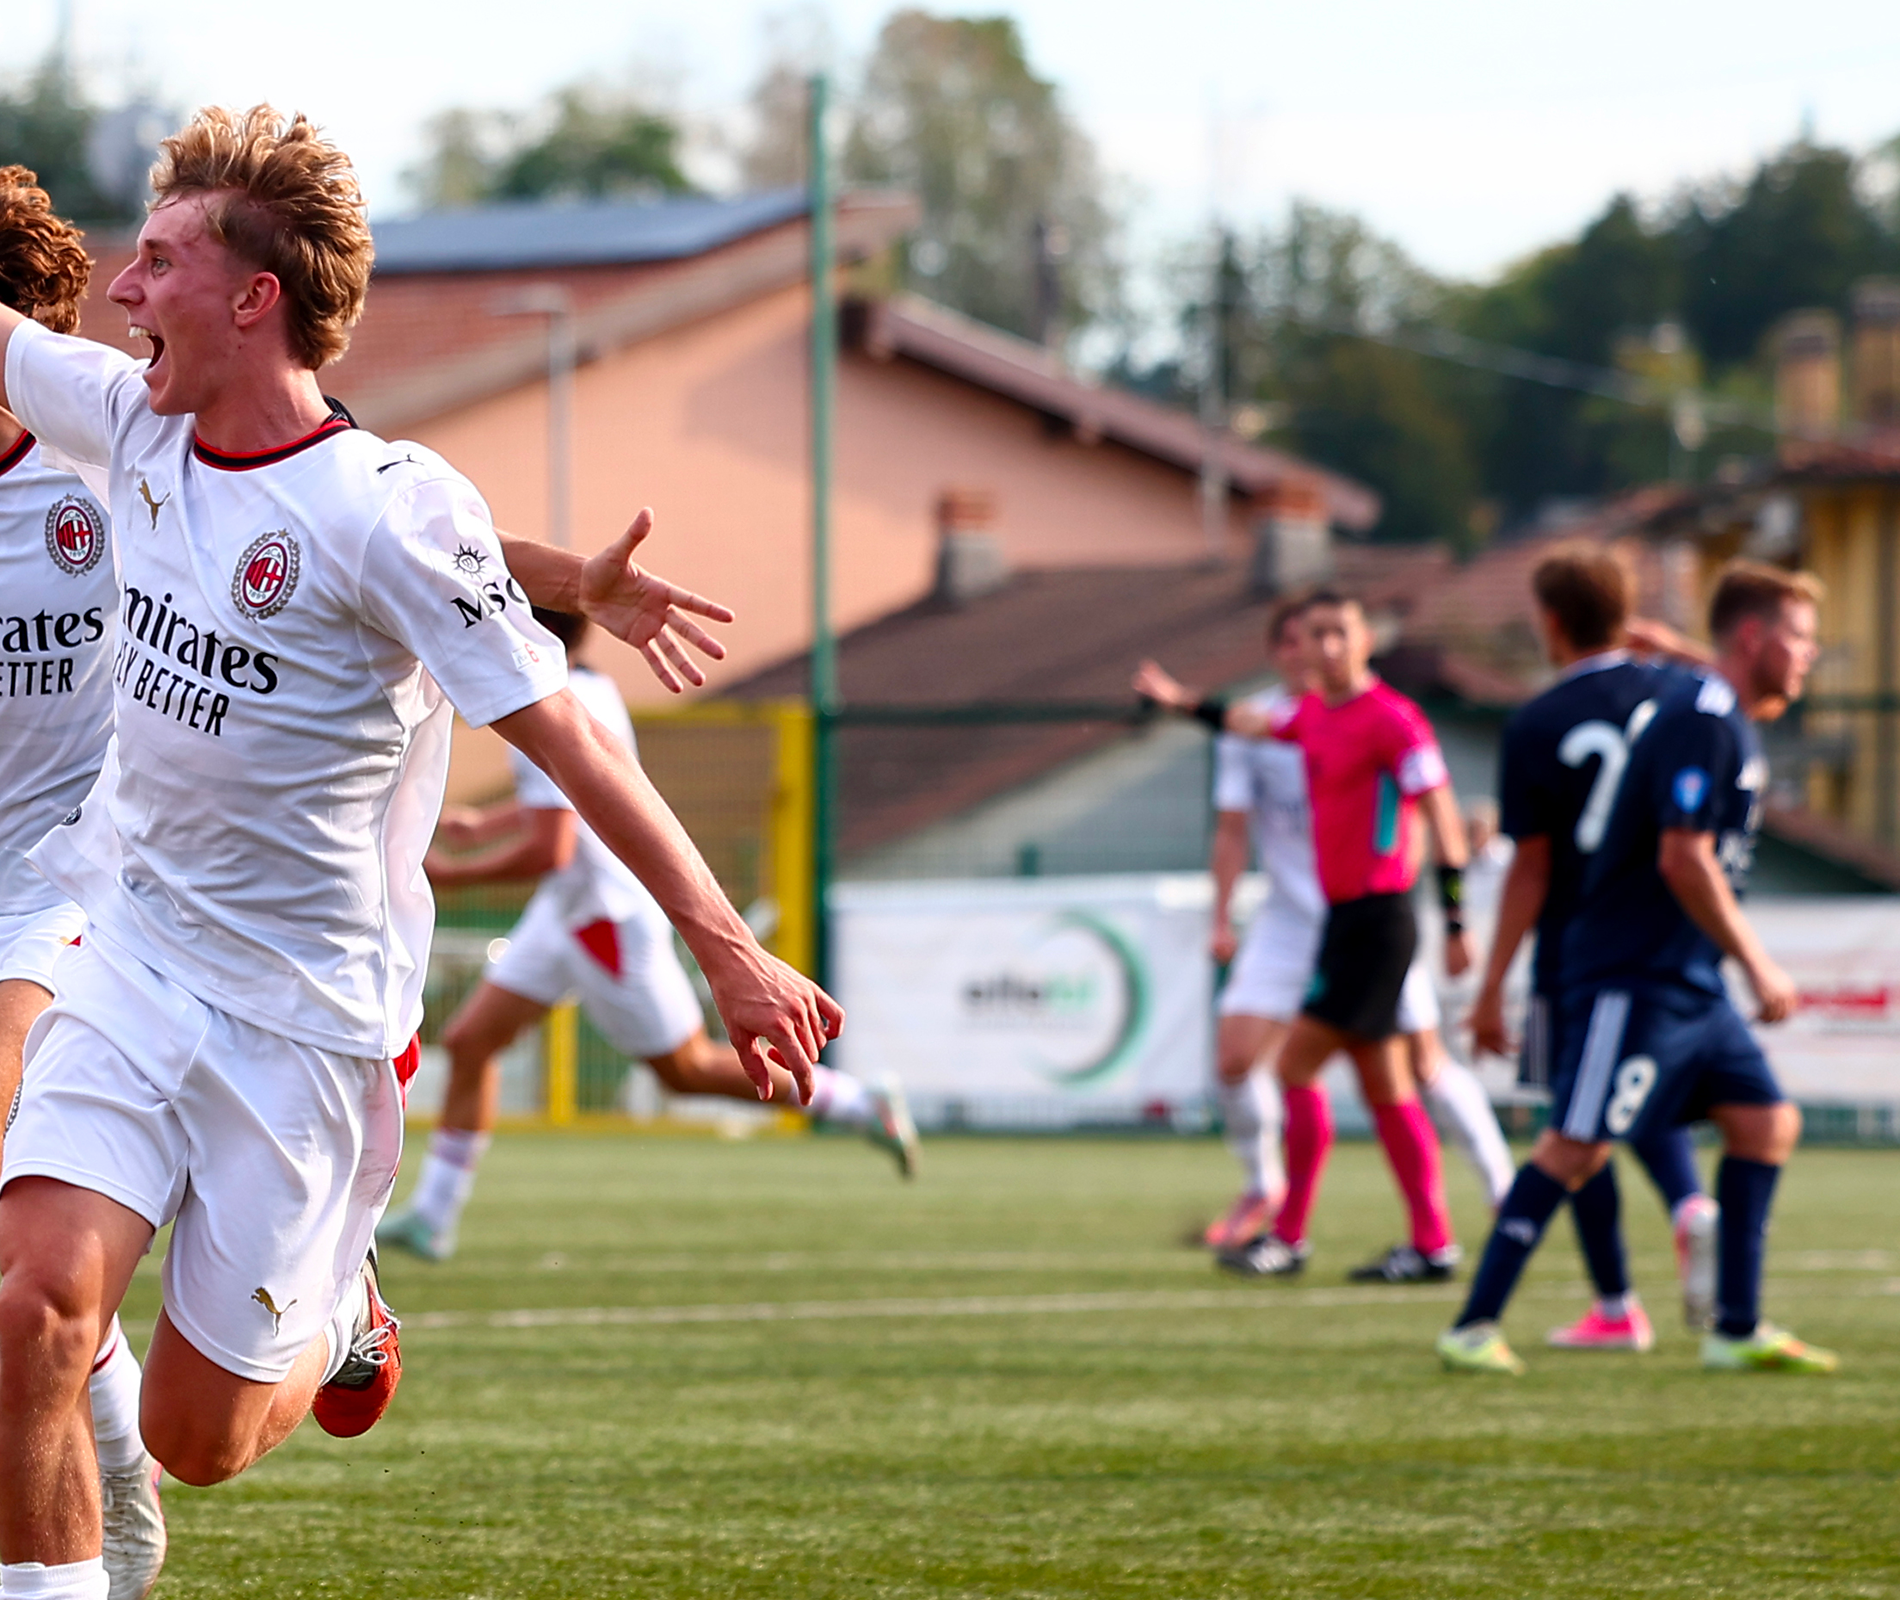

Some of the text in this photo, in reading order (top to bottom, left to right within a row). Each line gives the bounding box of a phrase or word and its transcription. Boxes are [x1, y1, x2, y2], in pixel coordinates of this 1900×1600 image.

[248, 589, 267, 600] 1899
[450, 577, 527, 629] MSC
[122, 581, 279, 695] mirates
[133, 658, 231, 738] BETTER
[1604, 1053, 1658, 1136] 8
